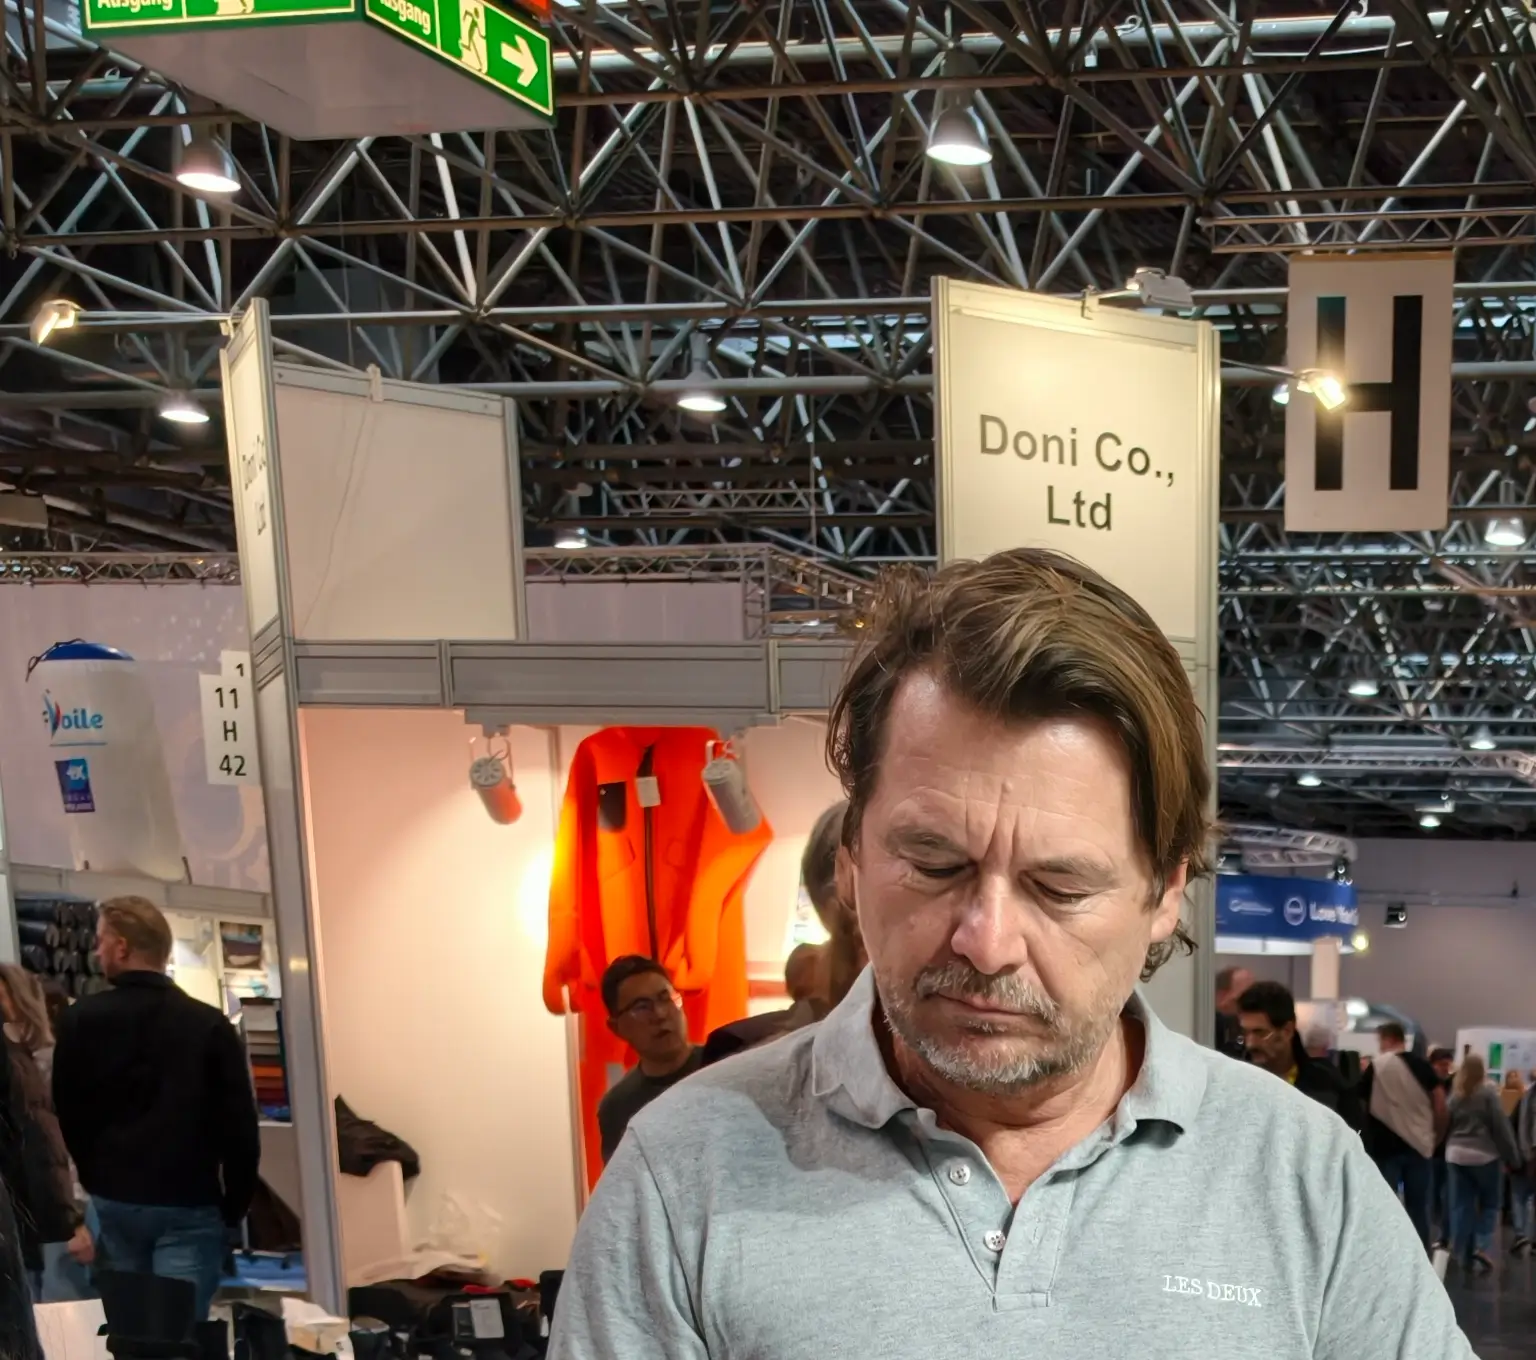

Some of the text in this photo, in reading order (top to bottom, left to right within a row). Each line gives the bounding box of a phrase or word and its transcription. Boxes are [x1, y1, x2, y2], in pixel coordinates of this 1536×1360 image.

[1314, 295, 1423, 491] H
[979, 414, 1175, 487] Doni Co.,
[1047, 486, 1113, 531] Ltd
[214, 687, 239, 709] 11
[222, 720, 238, 742] H
[218, 754, 247, 776] 42
[1162, 1274, 1262, 1307] LES DEUX
